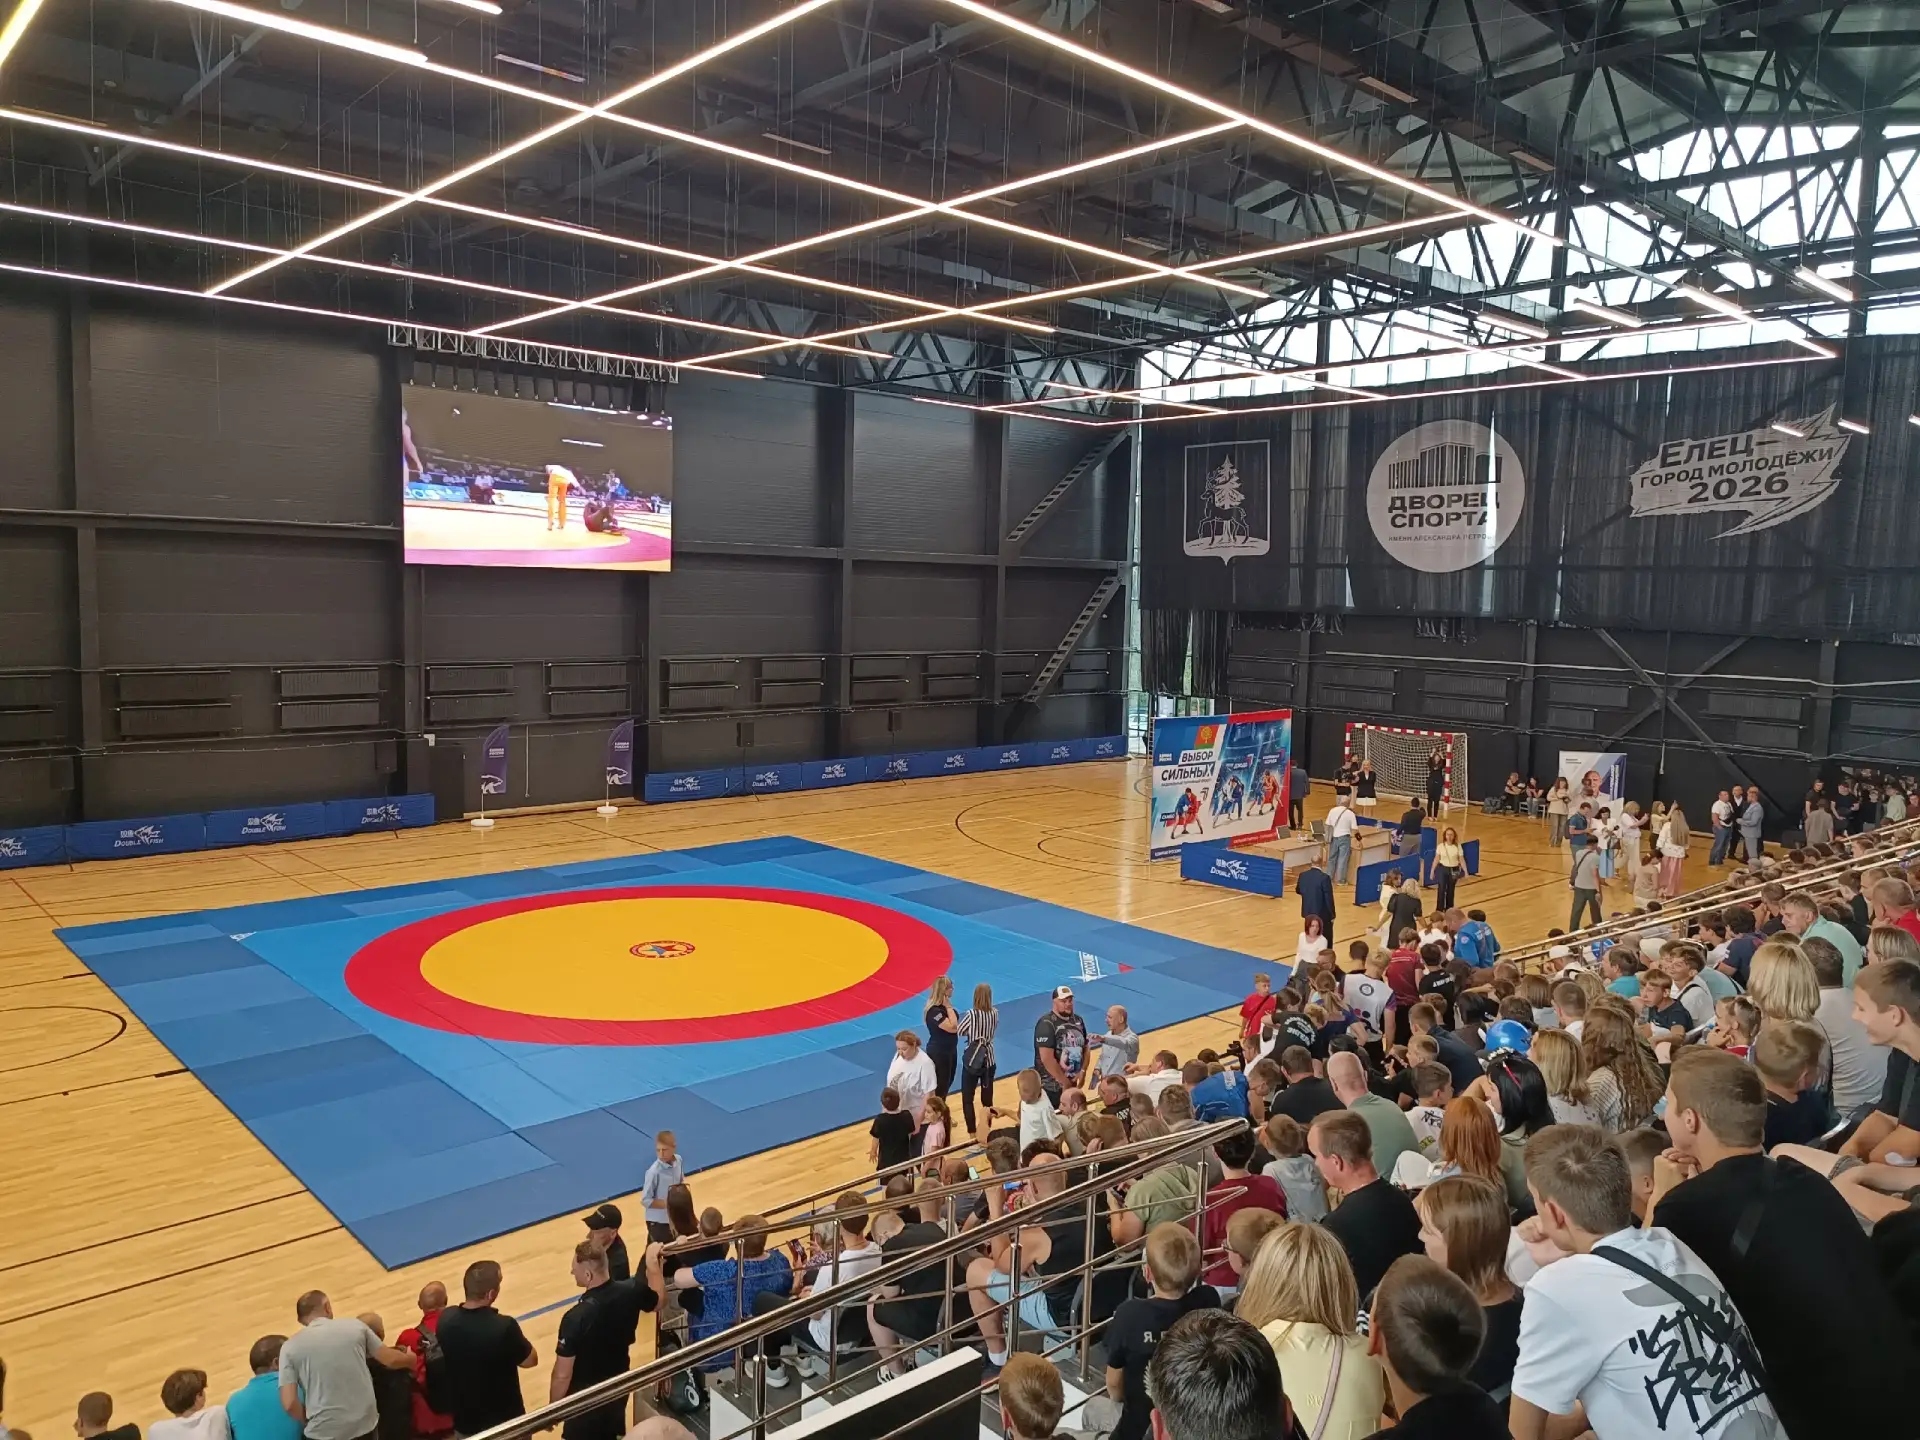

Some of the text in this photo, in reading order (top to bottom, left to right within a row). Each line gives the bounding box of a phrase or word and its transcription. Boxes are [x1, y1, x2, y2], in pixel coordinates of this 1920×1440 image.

[1660, 434, 1754, 468] ЕЛЕЦ
[1640, 447, 1834, 488] ГОРОД МОЛОДЁЖИ
[1687, 471, 1789, 504] 2026
[1388, 492, 1500, 513] ДВОРЕЦ
[1414, 534, 1461, 542] АЛЕКСАНДРА
[1463, 533, 1493, 541] ПЕТРО
[1181, 751, 1214, 763] ВЫБОР
[1161, 763, 1216, 781] СИЛЬНЫХ
